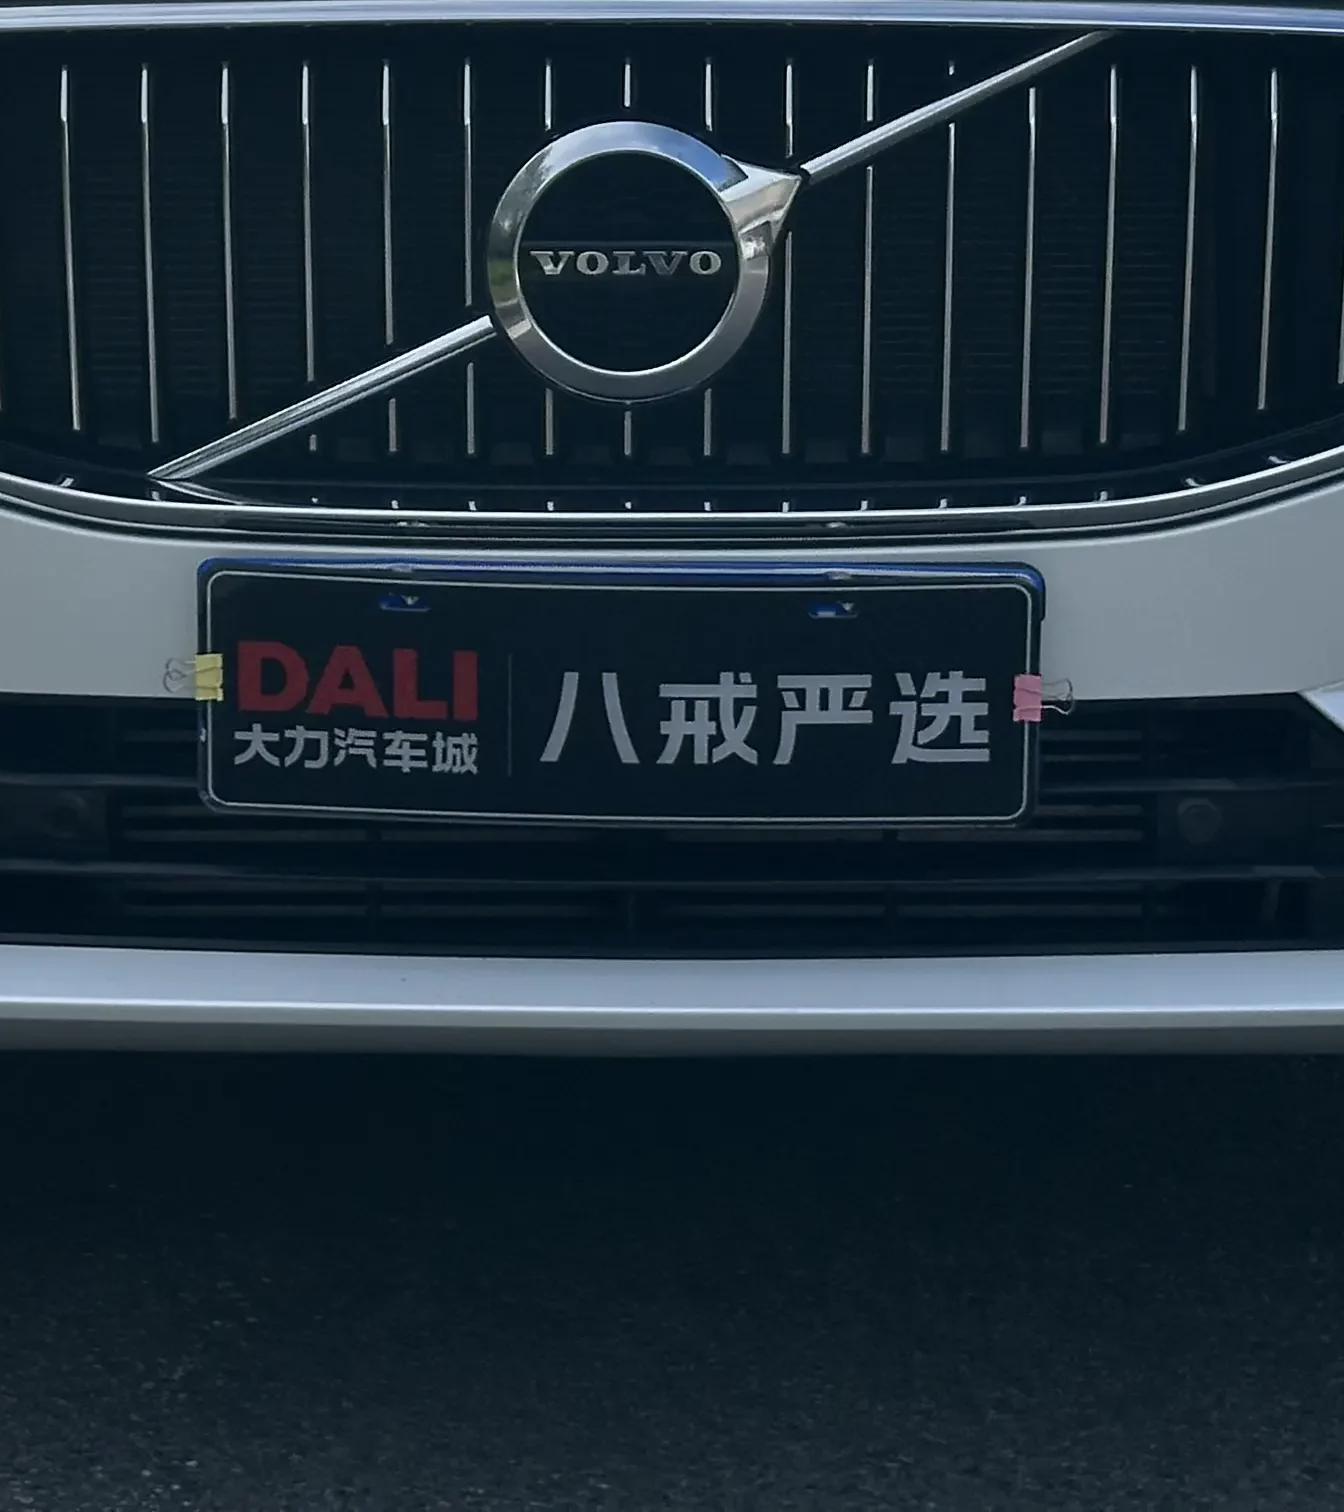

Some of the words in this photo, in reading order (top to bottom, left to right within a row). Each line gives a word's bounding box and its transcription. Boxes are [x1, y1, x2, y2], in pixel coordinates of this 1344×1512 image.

[529, 250, 722, 276] VOLVO
[236, 640, 479, 721] DALI
[233, 722, 479, 775] 大力汽车城
[539, 670, 991, 766] 八戒严选
